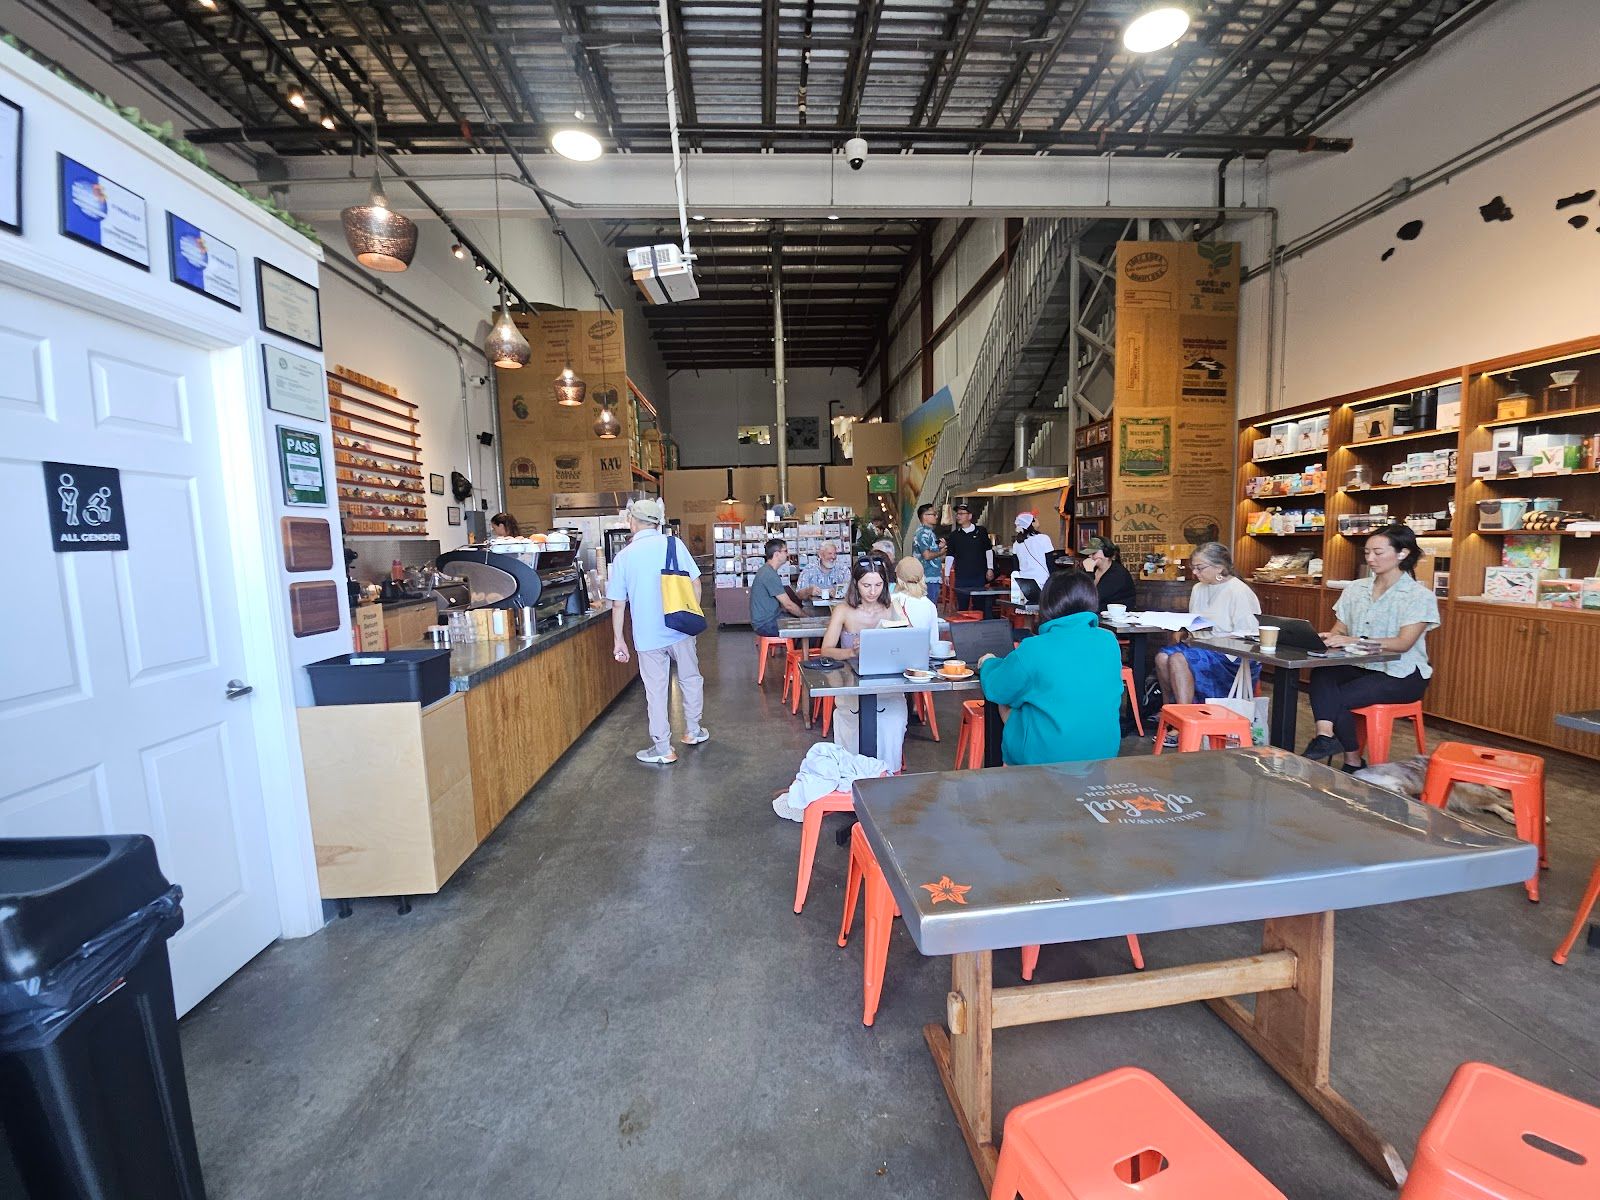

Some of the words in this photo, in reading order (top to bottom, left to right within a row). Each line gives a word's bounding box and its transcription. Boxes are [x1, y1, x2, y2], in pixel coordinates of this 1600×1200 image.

[286, 438, 318, 455] PASS
[1113, 503, 1168, 523] CAMEC
[60, 533, 80, 543] ALL
[81, 533, 121, 543] GENDER
[1114, 534, 1136, 543] CLEAN
[1138, 534, 1167, 543] COFFEE
[1084, 786, 1158, 797] TRADITION
[1087, 782, 1137, 791] COFFEE
